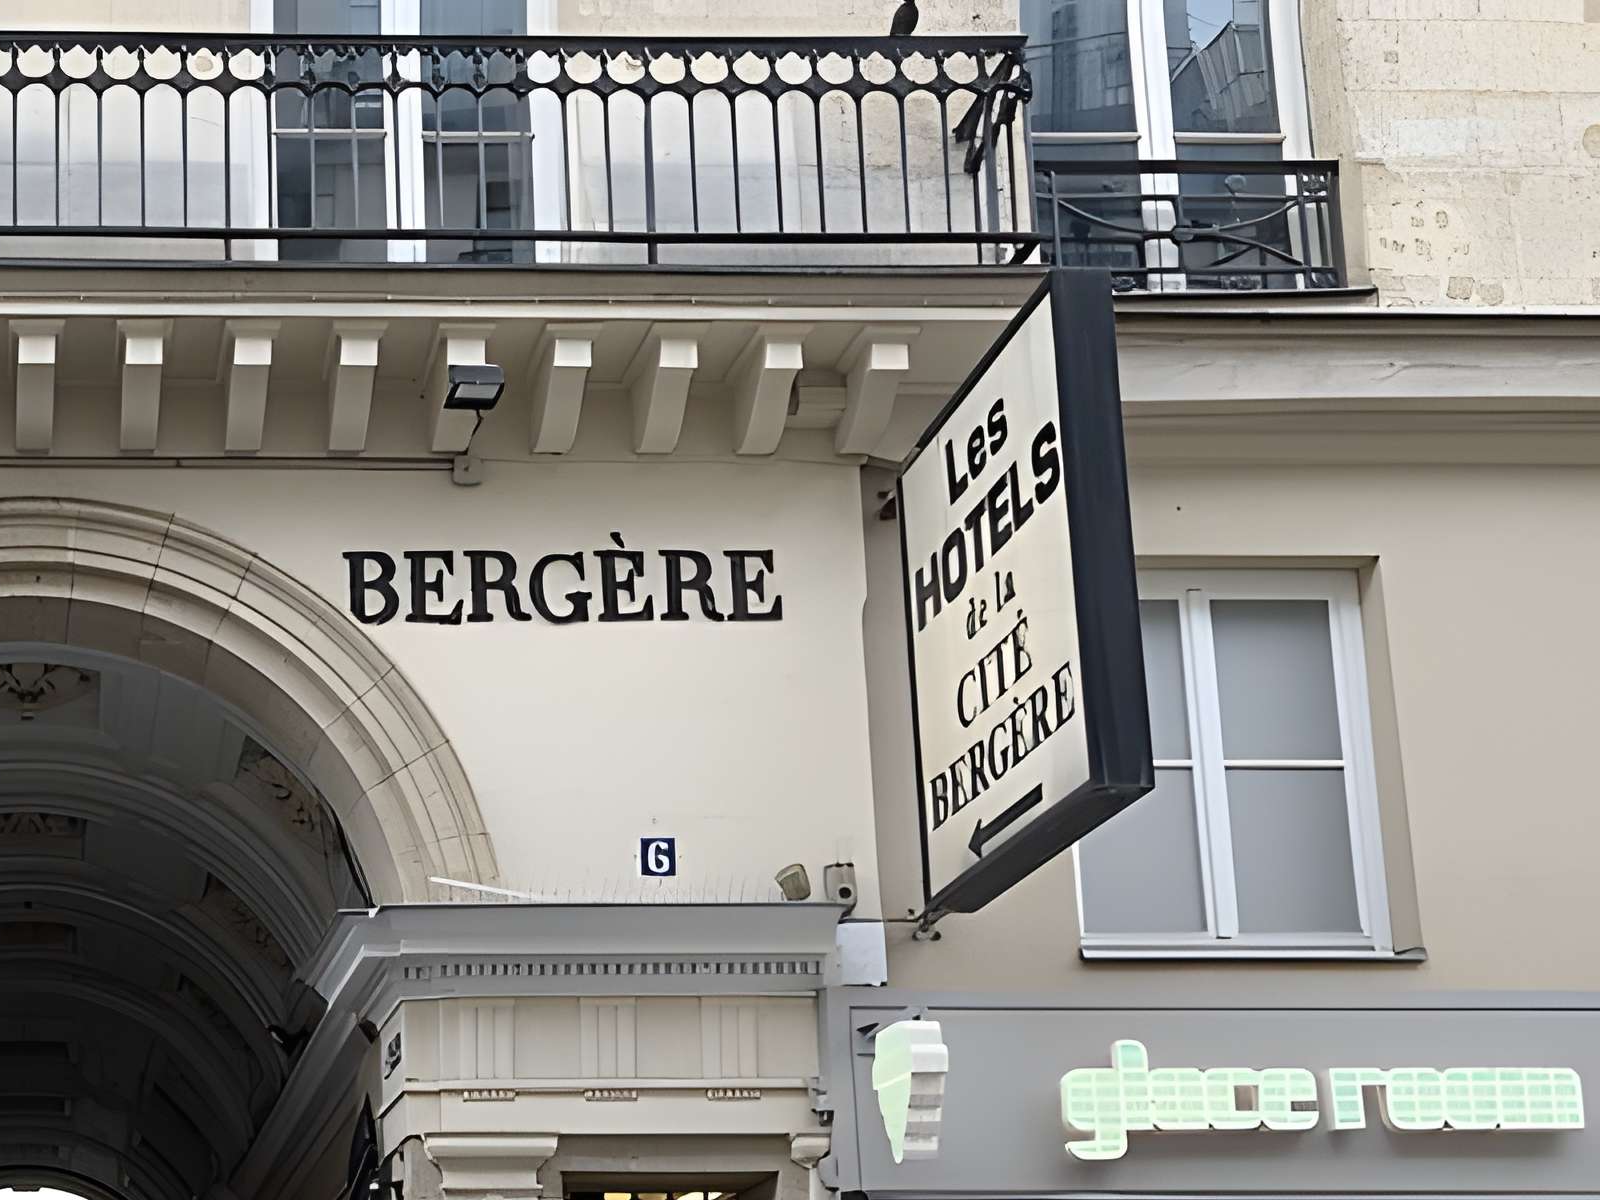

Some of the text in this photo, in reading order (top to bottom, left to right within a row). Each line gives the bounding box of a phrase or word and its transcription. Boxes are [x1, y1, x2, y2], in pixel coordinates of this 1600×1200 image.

[945, 398, 1008, 506] Les
[342, 531, 784, 625] BERGÈRE
[915, 421, 1061, 632] HOTELS
[966, 571, 1016, 640] de la
[957, 608, 1032, 728] CITÉ
[929, 660, 1075, 831] BERGÈRE
[647, 840, 670, 873] 6
